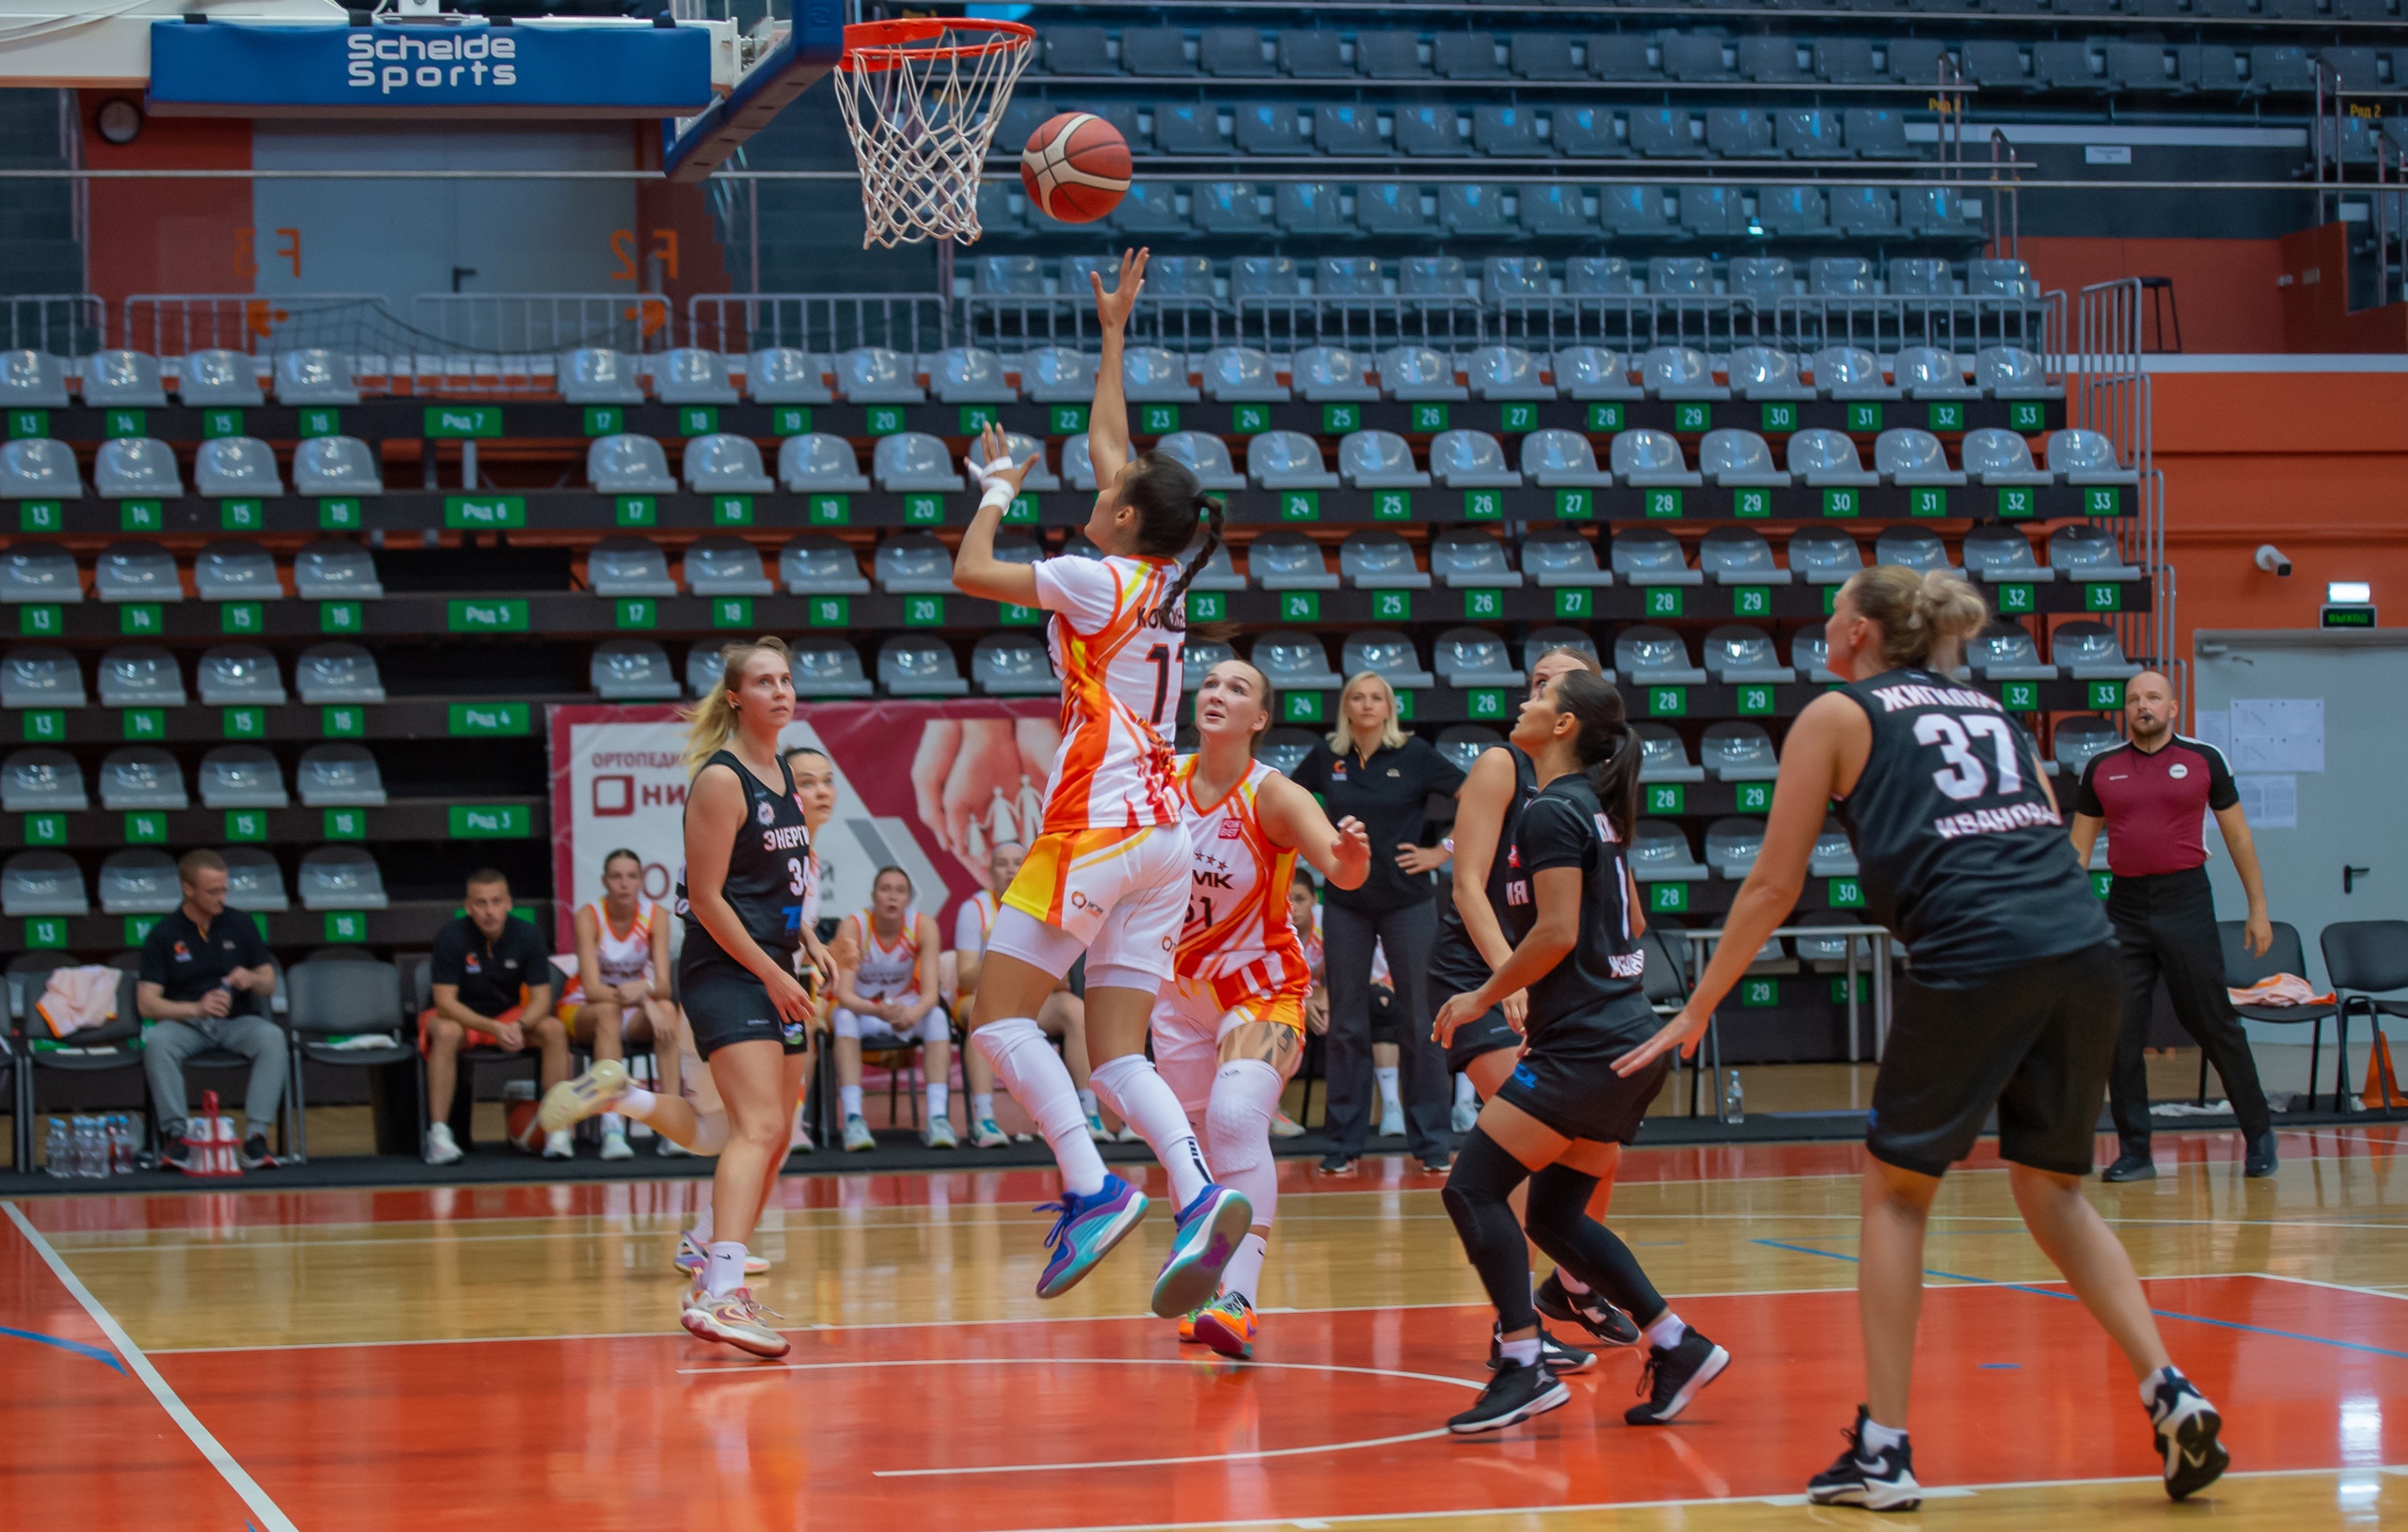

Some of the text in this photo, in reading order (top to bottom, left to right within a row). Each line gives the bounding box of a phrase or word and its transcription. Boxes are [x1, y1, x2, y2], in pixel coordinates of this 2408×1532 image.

[347, 34, 516, 60] Schelde
[347, 61, 517, 94] Sports
[2374, 104, 2382, 118] 2
[475, 413, 483, 429] 7
[596, 412, 611, 428] 17
[877, 412, 895, 430] 20
[1060, 411, 1078, 429] 22
[1151, 410, 1170, 428] 23
[1333, 409, 1351, 426] 25
[1422, 408, 1440, 426] 26
[1511, 407, 1528, 426] 27
[1598, 408, 1616, 426] 28
[1685, 408, 1703, 425] 29
[1771, 408, 1789, 425] 30
[1859, 408, 1873, 425] 31
[1939, 407, 1956, 424] 32
[2020, 406, 2036, 424] 33
[21, 416, 37, 434] 13
[215, 416, 231, 433] 15
[628, 501, 643, 518] 17
[914, 499, 935, 518] 20
[1012, 498, 1027, 516] 21
[1383, 496, 1402, 514] 25
[1474, 495, 1494, 513] 26
[1565, 495, 1583, 513] 27
[1655, 494, 1674, 513] 28
[1744, 494, 1762, 512] 29
[1832, 493, 1851, 511] 30
[1923, 493, 1937, 511] 31
[2008, 493, 2025, 511] 32
[2094, 492, 2112, 510] 33
[32, 506, 50, 526] 13
[233, 505, 250, 524] 15
[1383, 595, 1402, 614] 25
[1474, 594, 1494, 612] 26
[1565, 593, 1582, 611] 27
[1656, 592, 1674, 611] 28
[1744, 592, 1762, 610] 29
[2008, 589, 2026, 607] 32
[2096, 588, 2113, 606] 33
[628, 604, 644, 622] 17
[914, 601, 935, 620] 20
[1196, 598, 1216, 616] 23
[32, 609, 50, 629] 13
[233, 608, 251, 627] 15
[1478, 694, 1497, 713] 26
[1659, 691, 1678, 710] 28
[1748, 690, 1766, 708] 29
[2012, 687, 2029, 704] 32
[2099, 686, 2115, 703] 33
[35, 715, 53, 734] 13
[235, 712, 252, 731] 15
[1912, 712, 2022, 801] 37
[1656, 790, 1675, 808] 28
[1746, 788, 1765, 806] 29
[37, 819, 54, 838] 13
[237, 815, 255, 834] 15
[1661, 889, 1680, 906] 28
[1839, 884, 1858, 902] 30
[37, 923, 55, 942] 13
[1752, 986, 1770, 1002] 29
